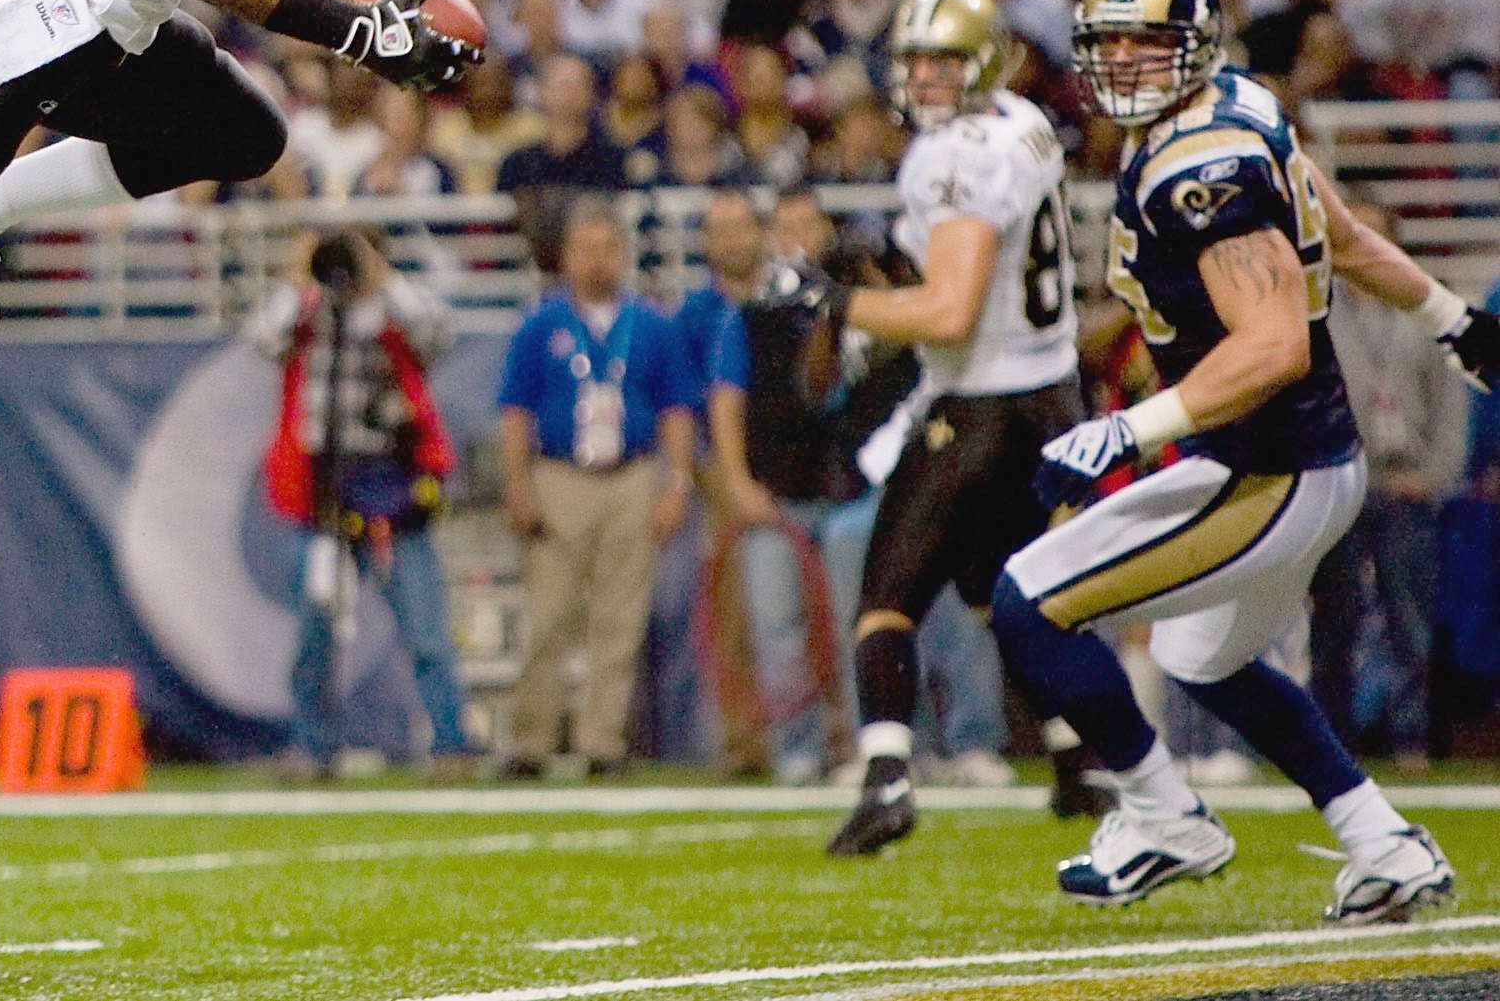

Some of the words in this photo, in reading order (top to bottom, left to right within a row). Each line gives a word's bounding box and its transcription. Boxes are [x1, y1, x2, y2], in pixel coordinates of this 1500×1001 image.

[35, 1, 57, 41] Wilson
[1023, 183, 1072, 329] 8
[26, 693, 101, 778] 10
